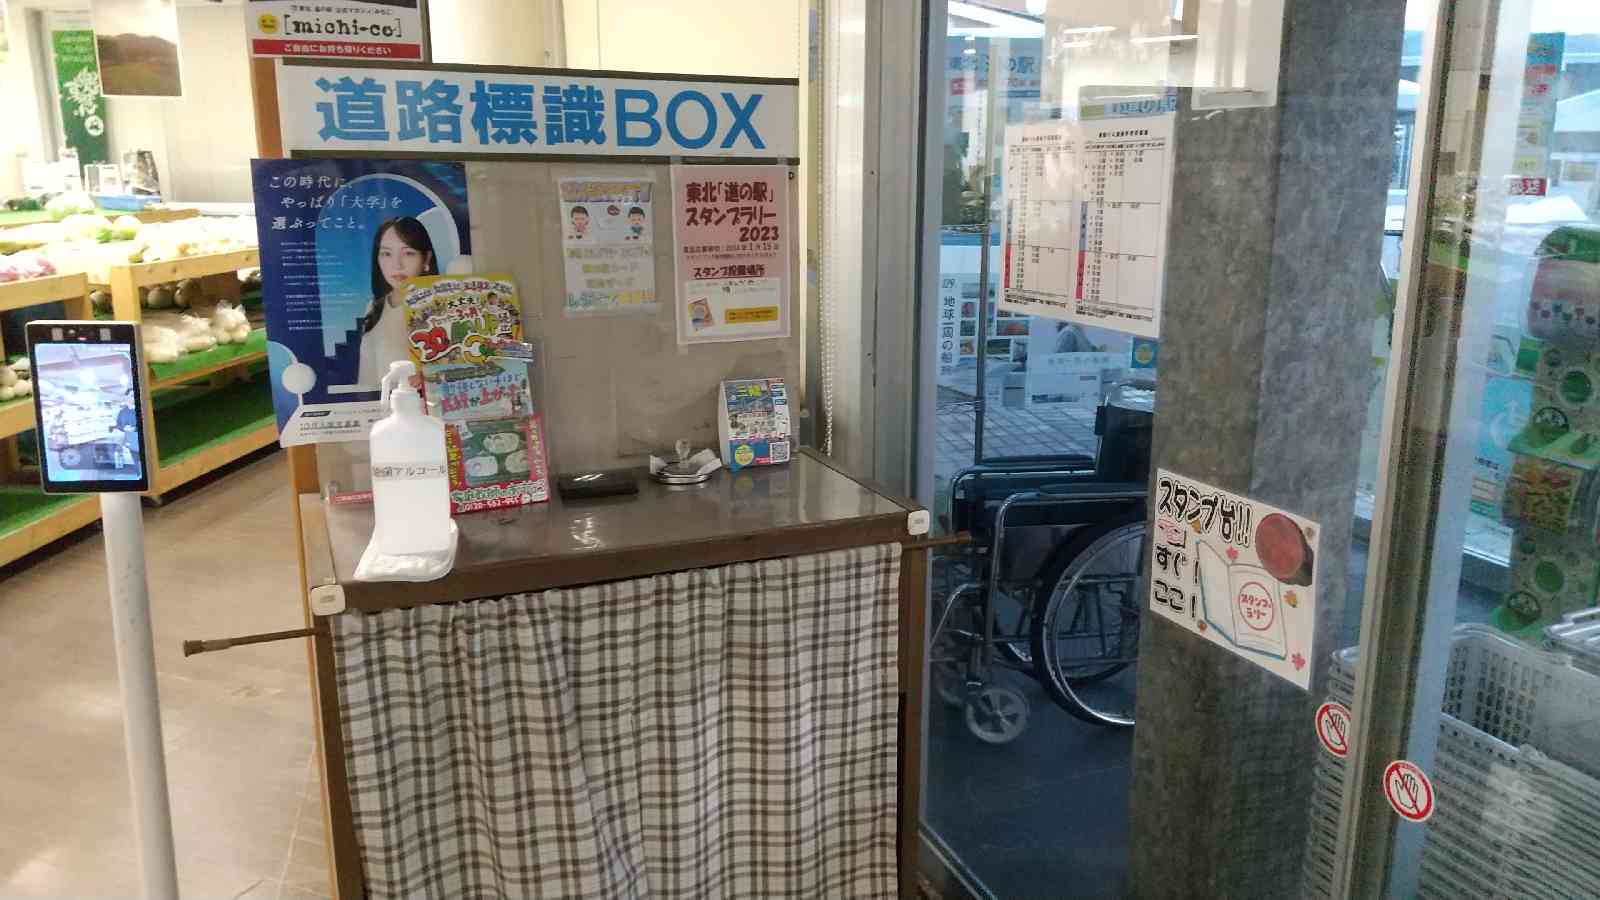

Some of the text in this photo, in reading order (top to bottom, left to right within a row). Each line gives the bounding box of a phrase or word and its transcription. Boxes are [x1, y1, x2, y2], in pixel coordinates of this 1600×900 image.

[283, 43, 392, 55] ご自由にお持ち帰りください
[315, 77, 766, 150] 道路標識BOX
[269, 175, 353, 189] この時代に、
[686, 181, 775, 202] 東北「道の駅」
[280, 196, 402, 209] やっぱり「大学」を
[271, 216, 366, 230] 選ぶってこと。
[686, 206, 776, 226] スタンプラリー
[739, 226, 780, 242] 2023
